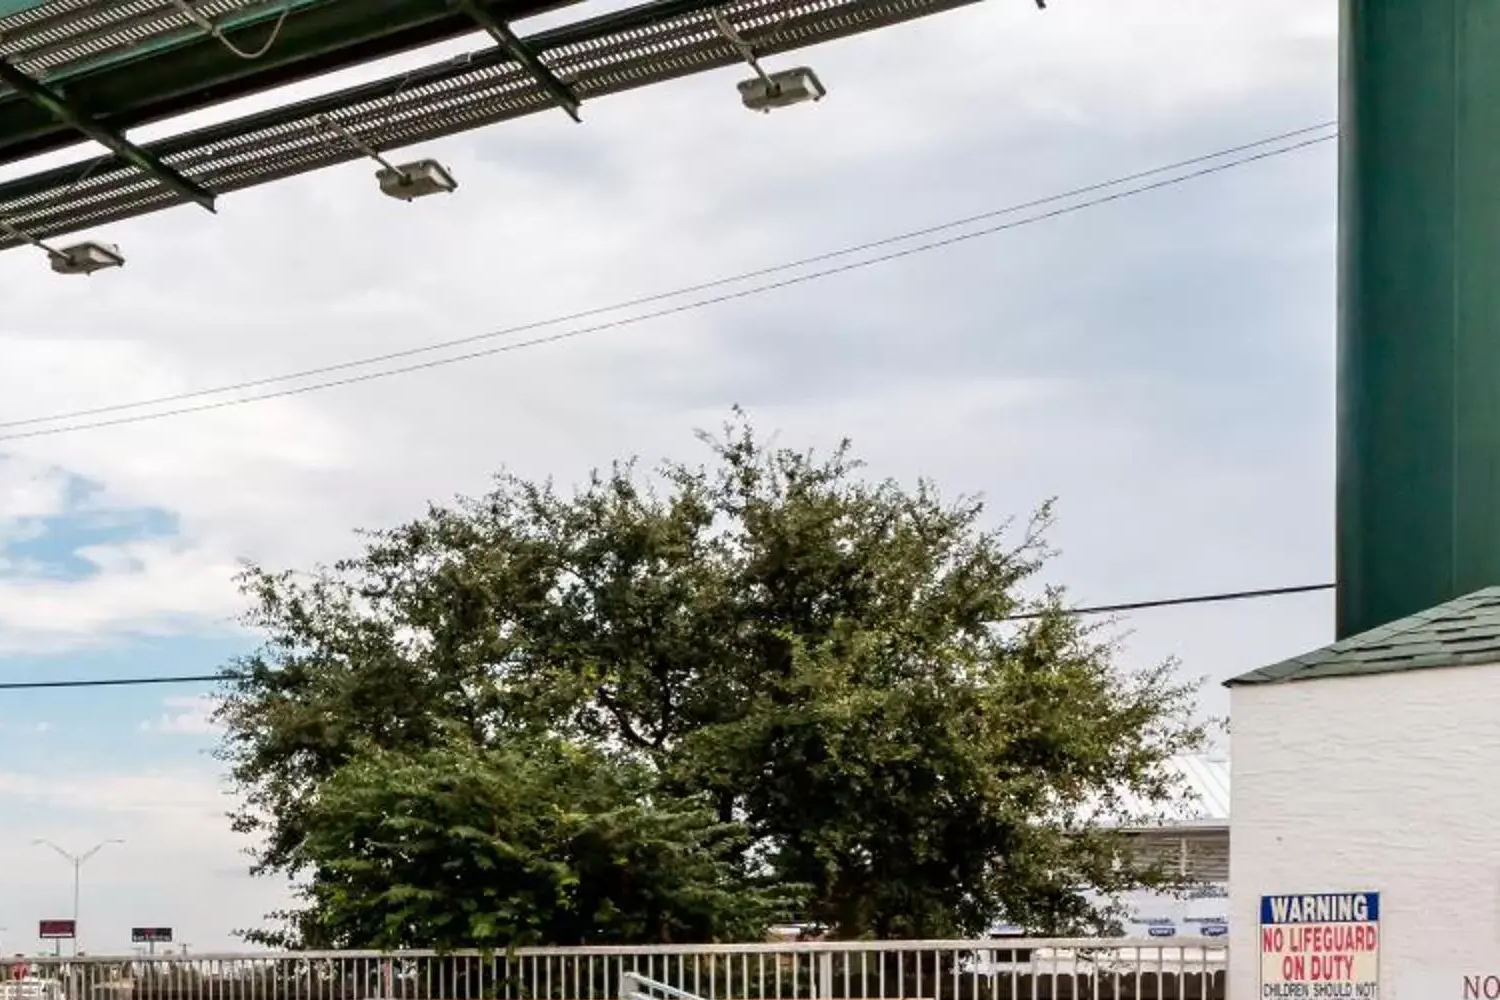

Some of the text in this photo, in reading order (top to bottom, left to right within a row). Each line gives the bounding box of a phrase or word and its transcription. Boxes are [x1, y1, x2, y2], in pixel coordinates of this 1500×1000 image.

[1270, 895, 1368, 923] WARNING
[1263, 926, 1376, 952] NO LIFEGUARD
[1283, 955, 1354, 981] ON DUTY
[1263, 982, 1377, 997] CHILDREN SHOULD NOT
[1463, 975, 1500, 1000] NO
